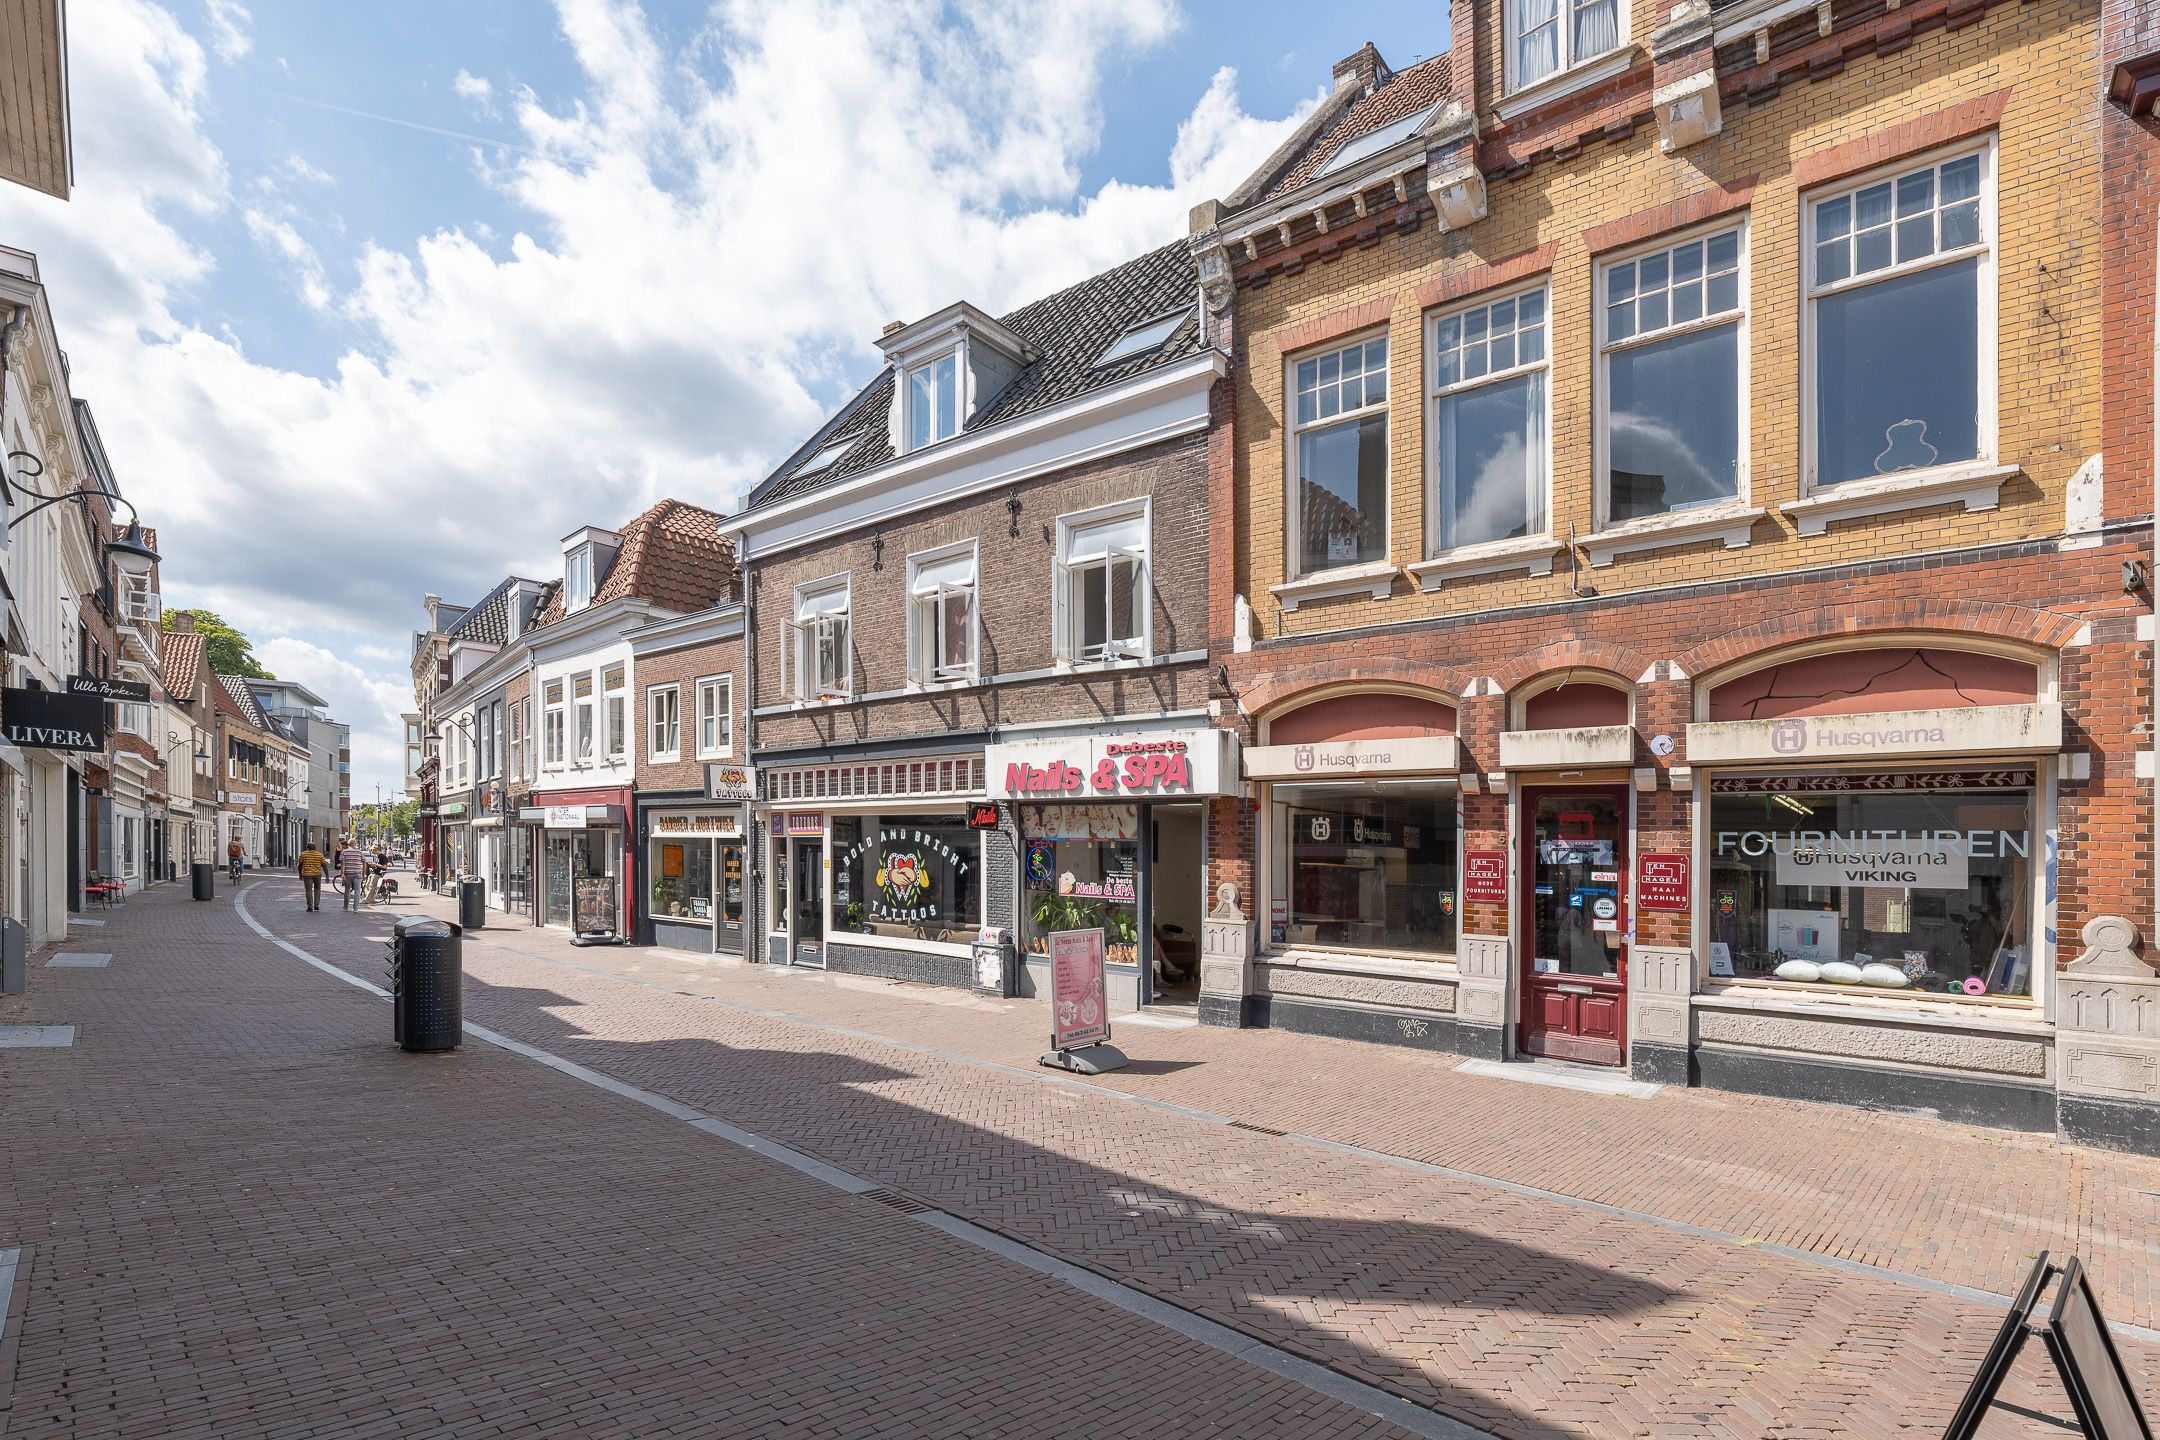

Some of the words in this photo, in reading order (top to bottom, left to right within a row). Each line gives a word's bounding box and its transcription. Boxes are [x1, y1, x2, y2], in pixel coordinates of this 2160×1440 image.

[73, 678, 98, 692] Ulla
[9, 725, 98, 747] LIVERA
[1816, 727, 1945, 748] Husqvarna
[1106, 740, 1188, 756] Debeste
[1319, 752, 1392, 768] Husqvarna
[1004, 759, 1083, 793] Nails
[1090, 758, 1117, 792] &
[1121, 753, 1190, 790] SPA
[715, 788, 753, 799] TATTOOS
[970, 807, 998, 826] Nails
[1364, 828, 1392, 842] Husqvarna
[842, 836, 873, 867] BOLD
[880, 828, 906, 843] AND
[914, 830, 969, 875] BRIGHT
[1718, 830, 2029, 858] FOURNITUREN
[1594, 872, 1616, 881] elna
[1845, 870, 1917, 882] VIKING
[1075, 881, 1102, 895] Nails
[1104, 883, 1113, 896] &
[1113, 884, 1136, 897] SPA
[1640, 894, 1687, 902] MACHINES
[872, 900, 937, 920] TATTOOS
